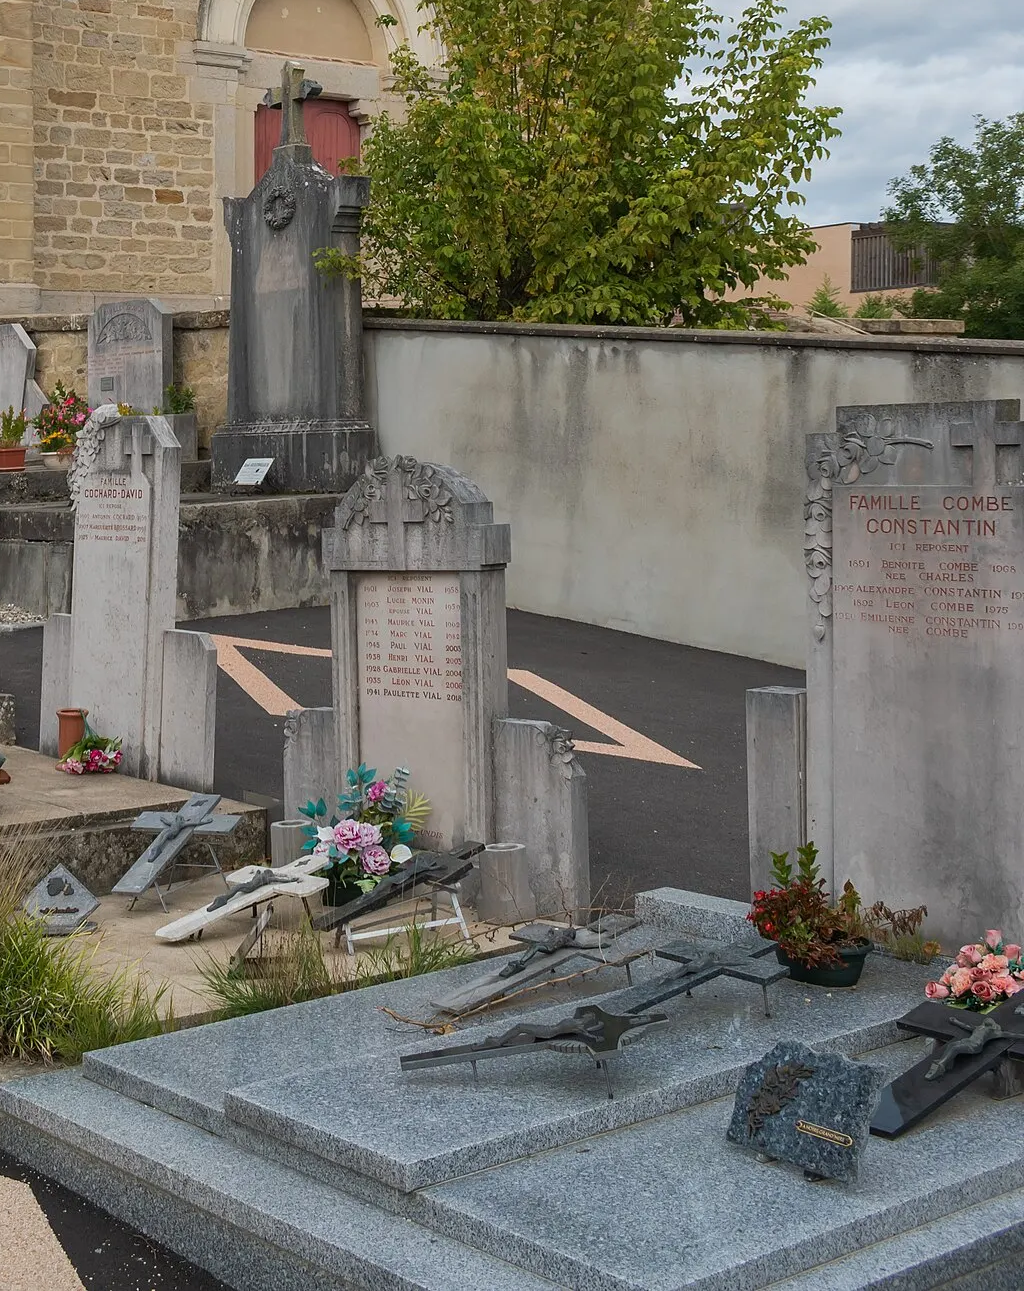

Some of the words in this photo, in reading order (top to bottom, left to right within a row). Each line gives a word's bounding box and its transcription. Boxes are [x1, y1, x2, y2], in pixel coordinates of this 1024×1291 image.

[101, 478, 127, 486] FAMILLE
[850, 496, 920, 510] FAMILLE
[943, 496, 1014, 511] COMBE
[866, 519, 996, 536] CONSTANTIN
[890, 543, 906, 551] ICI
[916, 543, 969, 553] REPOSENT
[849, 560, 870, 568] 1891
[882, 560, 925, 570] BENOITE
[939, 562, 978, 572] COMBE
[992, 565, 1016, 574] 1968
[919, 573, 974, 582] CHARLES
[856, 585, 915, 595] ALEXANDRE
[924, 587, 1001, 599] CONSTANTIN
[854, 599, 874, 607] 1892
[886, 599, 915, 609] LEON
[931, 603, 974, 612] COMBE
[985, 605, 1009, 614] 1975
[388, 619, 414, 627] MAURICE
[861, 613, 915, 624] EMILIENNE
[926, 617, 1001, 629] CONSTANTIN
[926, 627, 968, 638] COMBE
[391, 642, 407, 650] PAUL
[414, 642, 433, 651] VIAL
[389, 654, 408, 662] HENRI
[415, 655, 434, 663] VIAL
[383, 665, 420, 675] GABRIELLE
[424, 668, 442, 676] VIAL
[415, 679, 434, 688] VIAL
[384, 689, 420, 699] PAULETTE
[423, 692, 442, 700] VIAL
